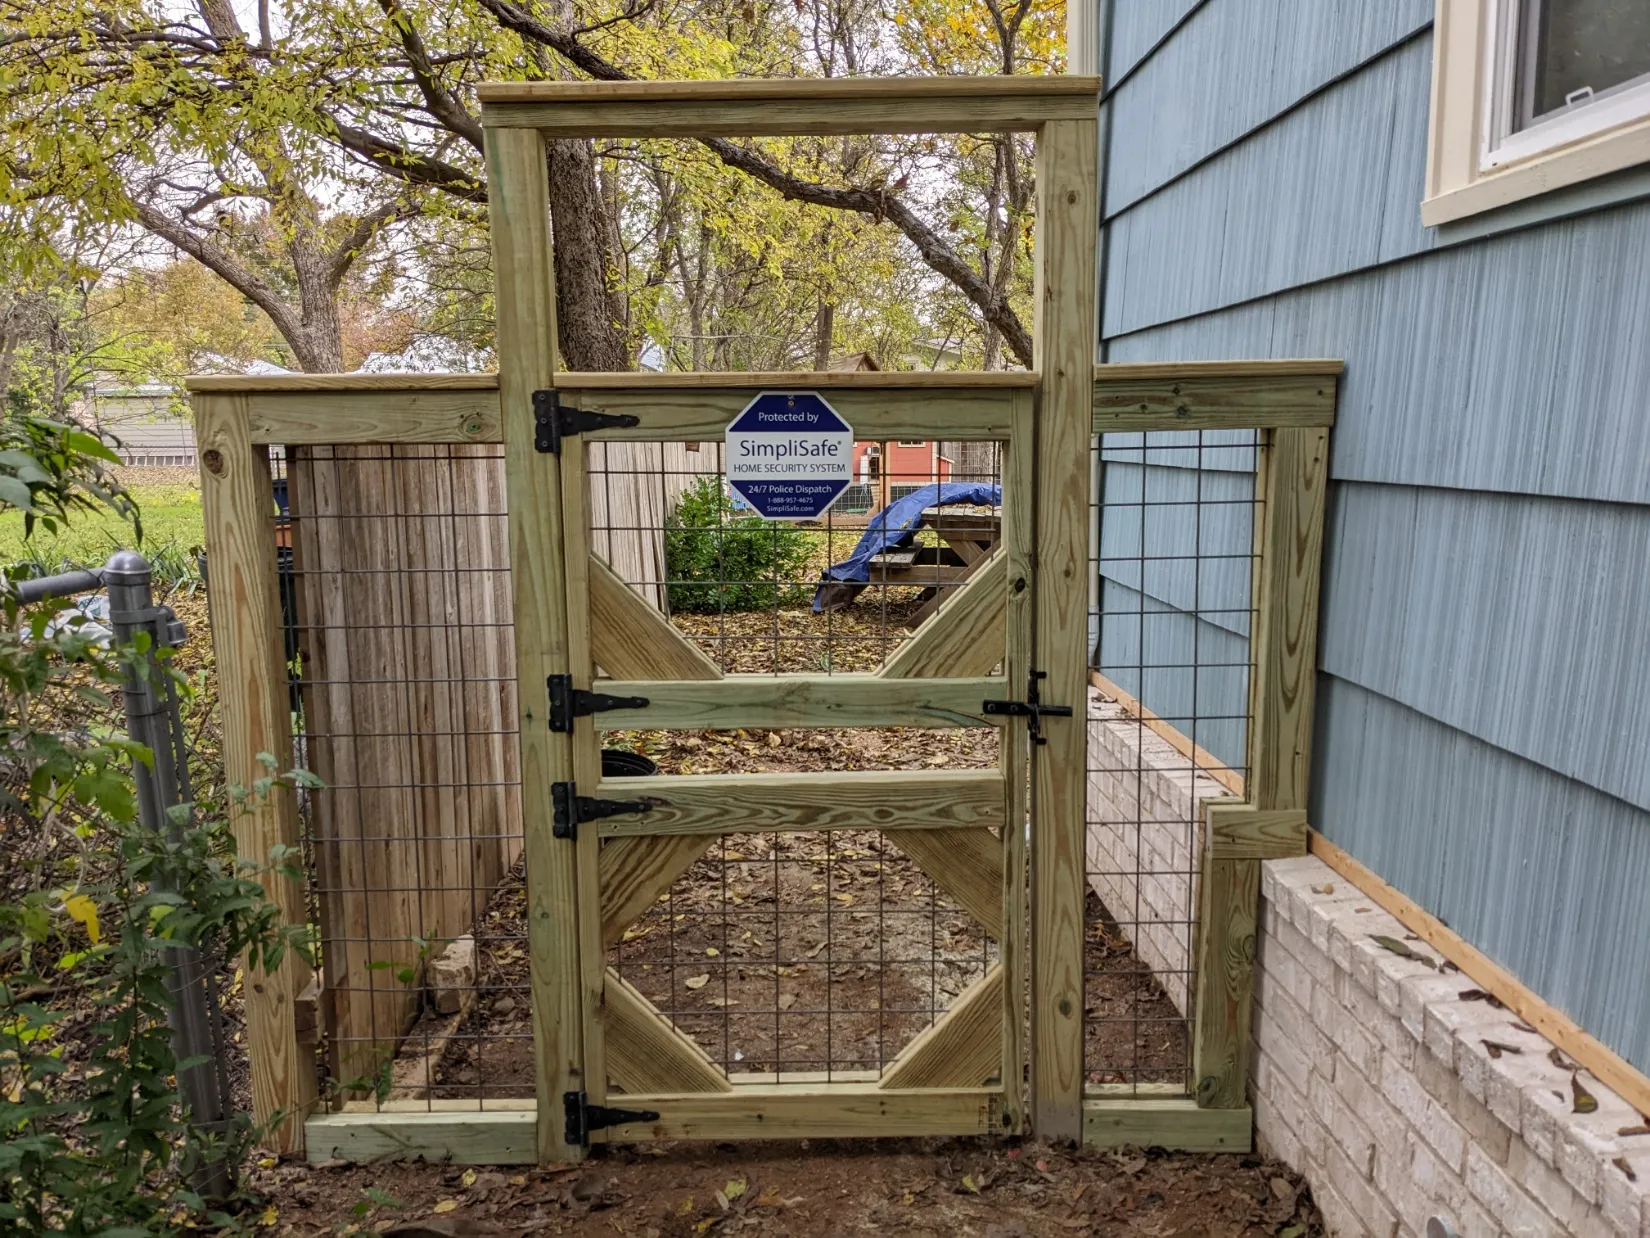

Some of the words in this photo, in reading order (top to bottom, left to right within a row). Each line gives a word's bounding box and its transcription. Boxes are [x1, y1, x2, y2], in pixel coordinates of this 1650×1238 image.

[758, 412, 805, 422] Protected
[806, 412, 819, 424] by
[733, 463, 763, 473] HOME
[764, 463, 808, 473] SECURITY
[809, 463, 846, 473] SYSTEM
[748, 485, 767, 494] 24/7
[769, 485, 794, 494] Police
[795, 485, 832, 495] Dispatch
[766, 505, 815, 513] SimpliSafe.com
